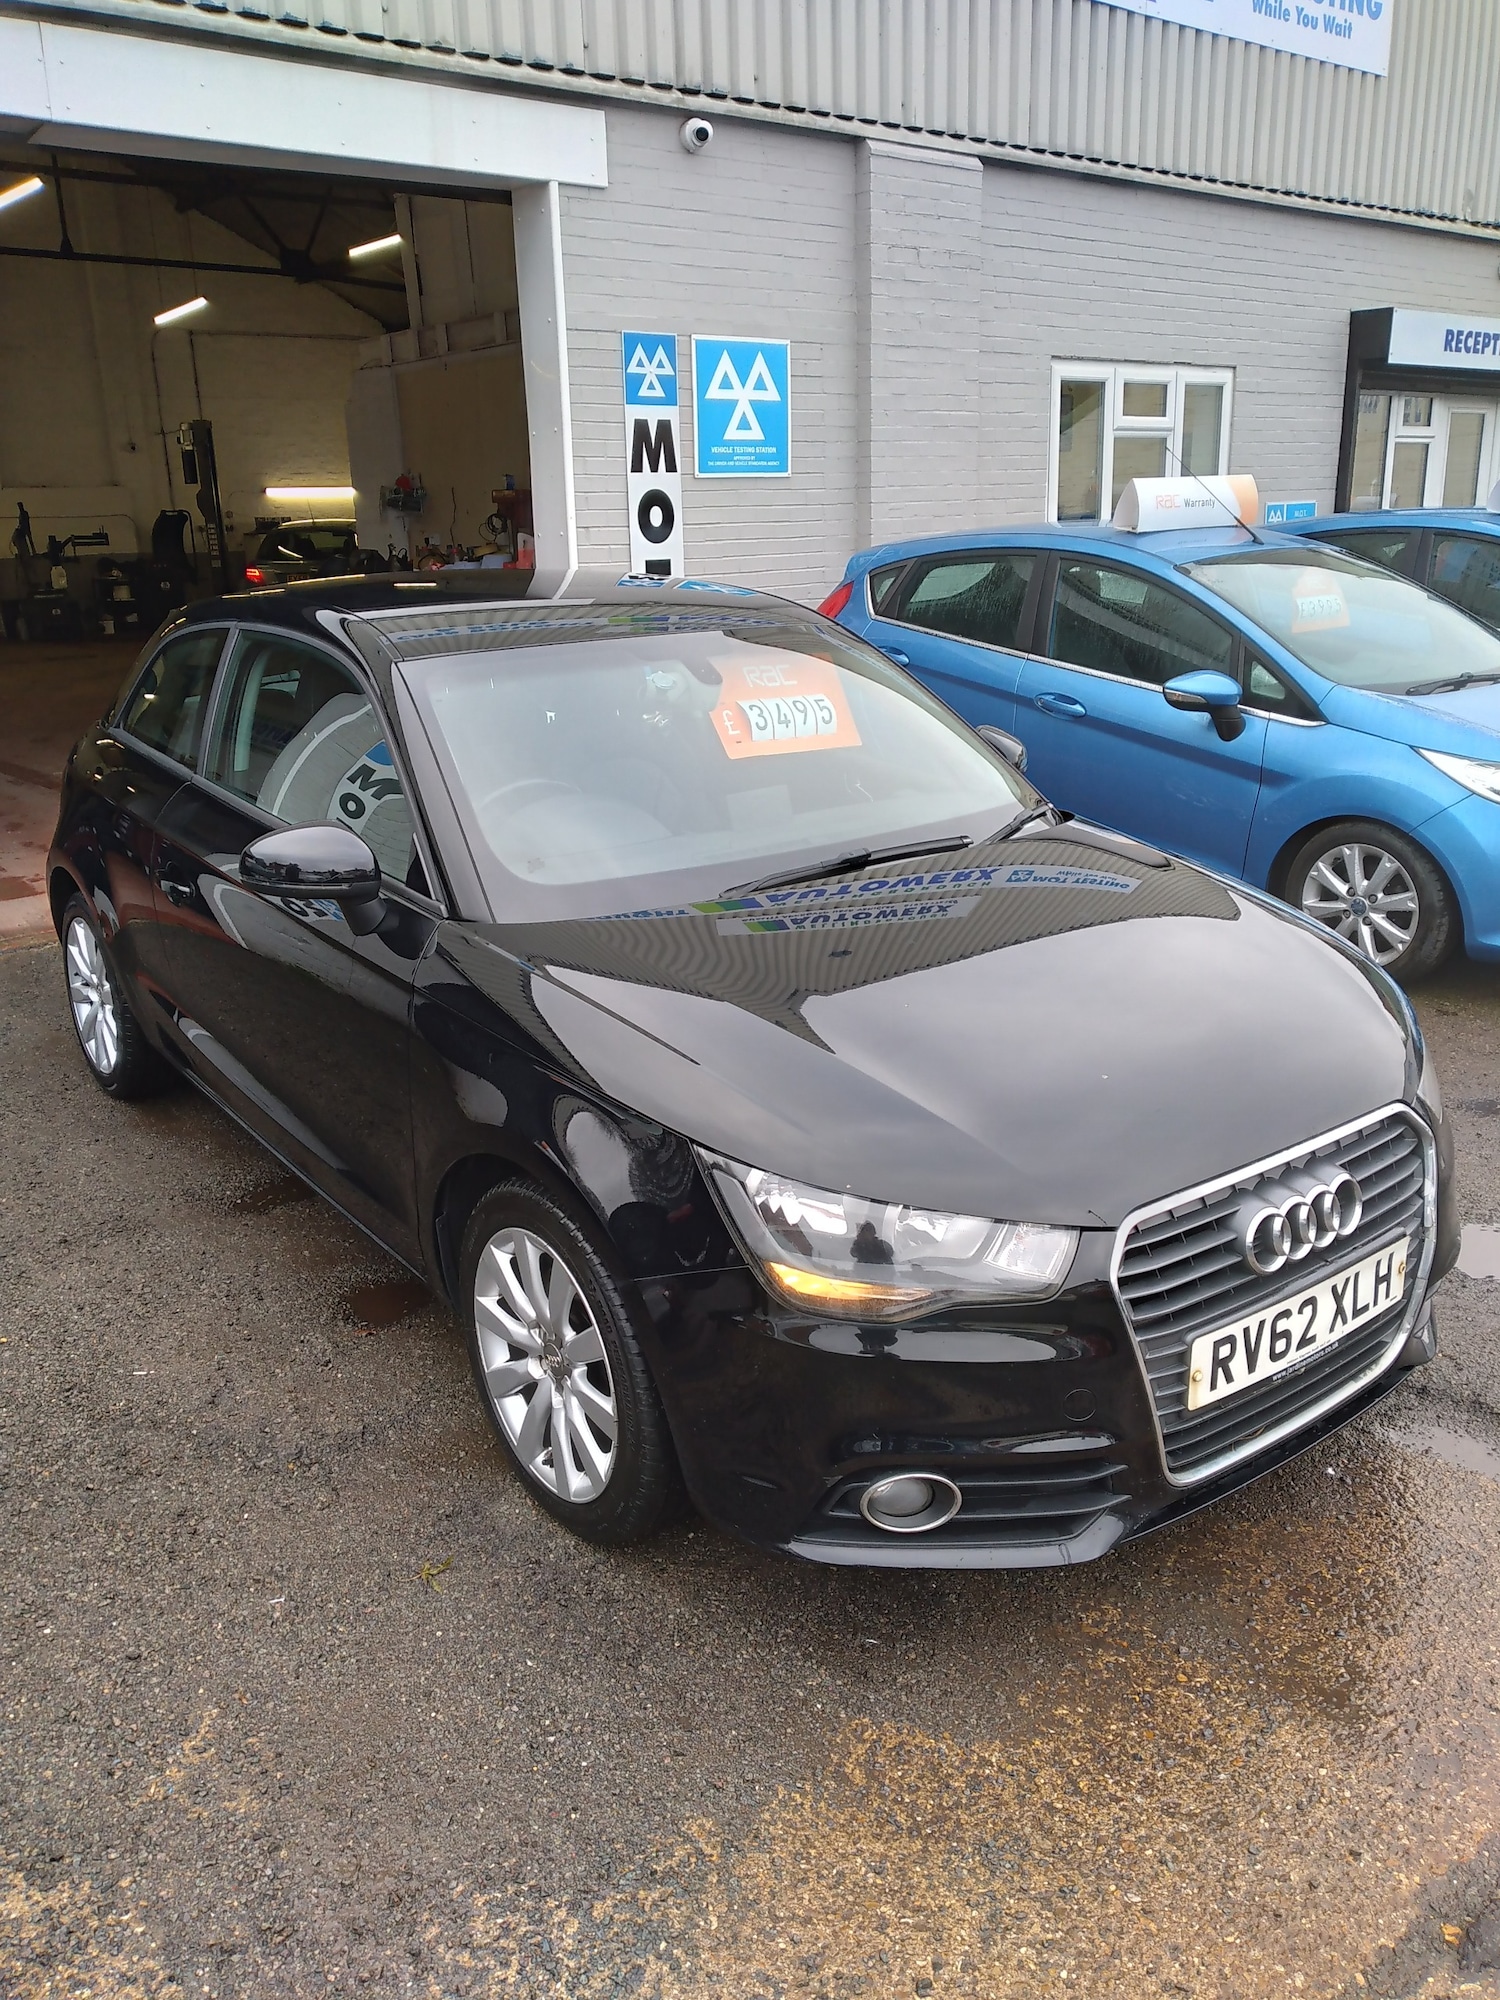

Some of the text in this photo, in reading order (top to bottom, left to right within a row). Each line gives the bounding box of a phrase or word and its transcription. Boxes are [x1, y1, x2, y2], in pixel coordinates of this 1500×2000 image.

[1252, 0, 1291, 22] While
[1295, 5, 1319, 30] You
[1323, 14, 1353, 39] Wait
[1444, 329, 1500, 355] RECEPT
[756, 446, 776, 454] STATION
[1184, 497, 1216, 509] Warranty
[1210, 1252, 1395, 1392] RV62 XLH
